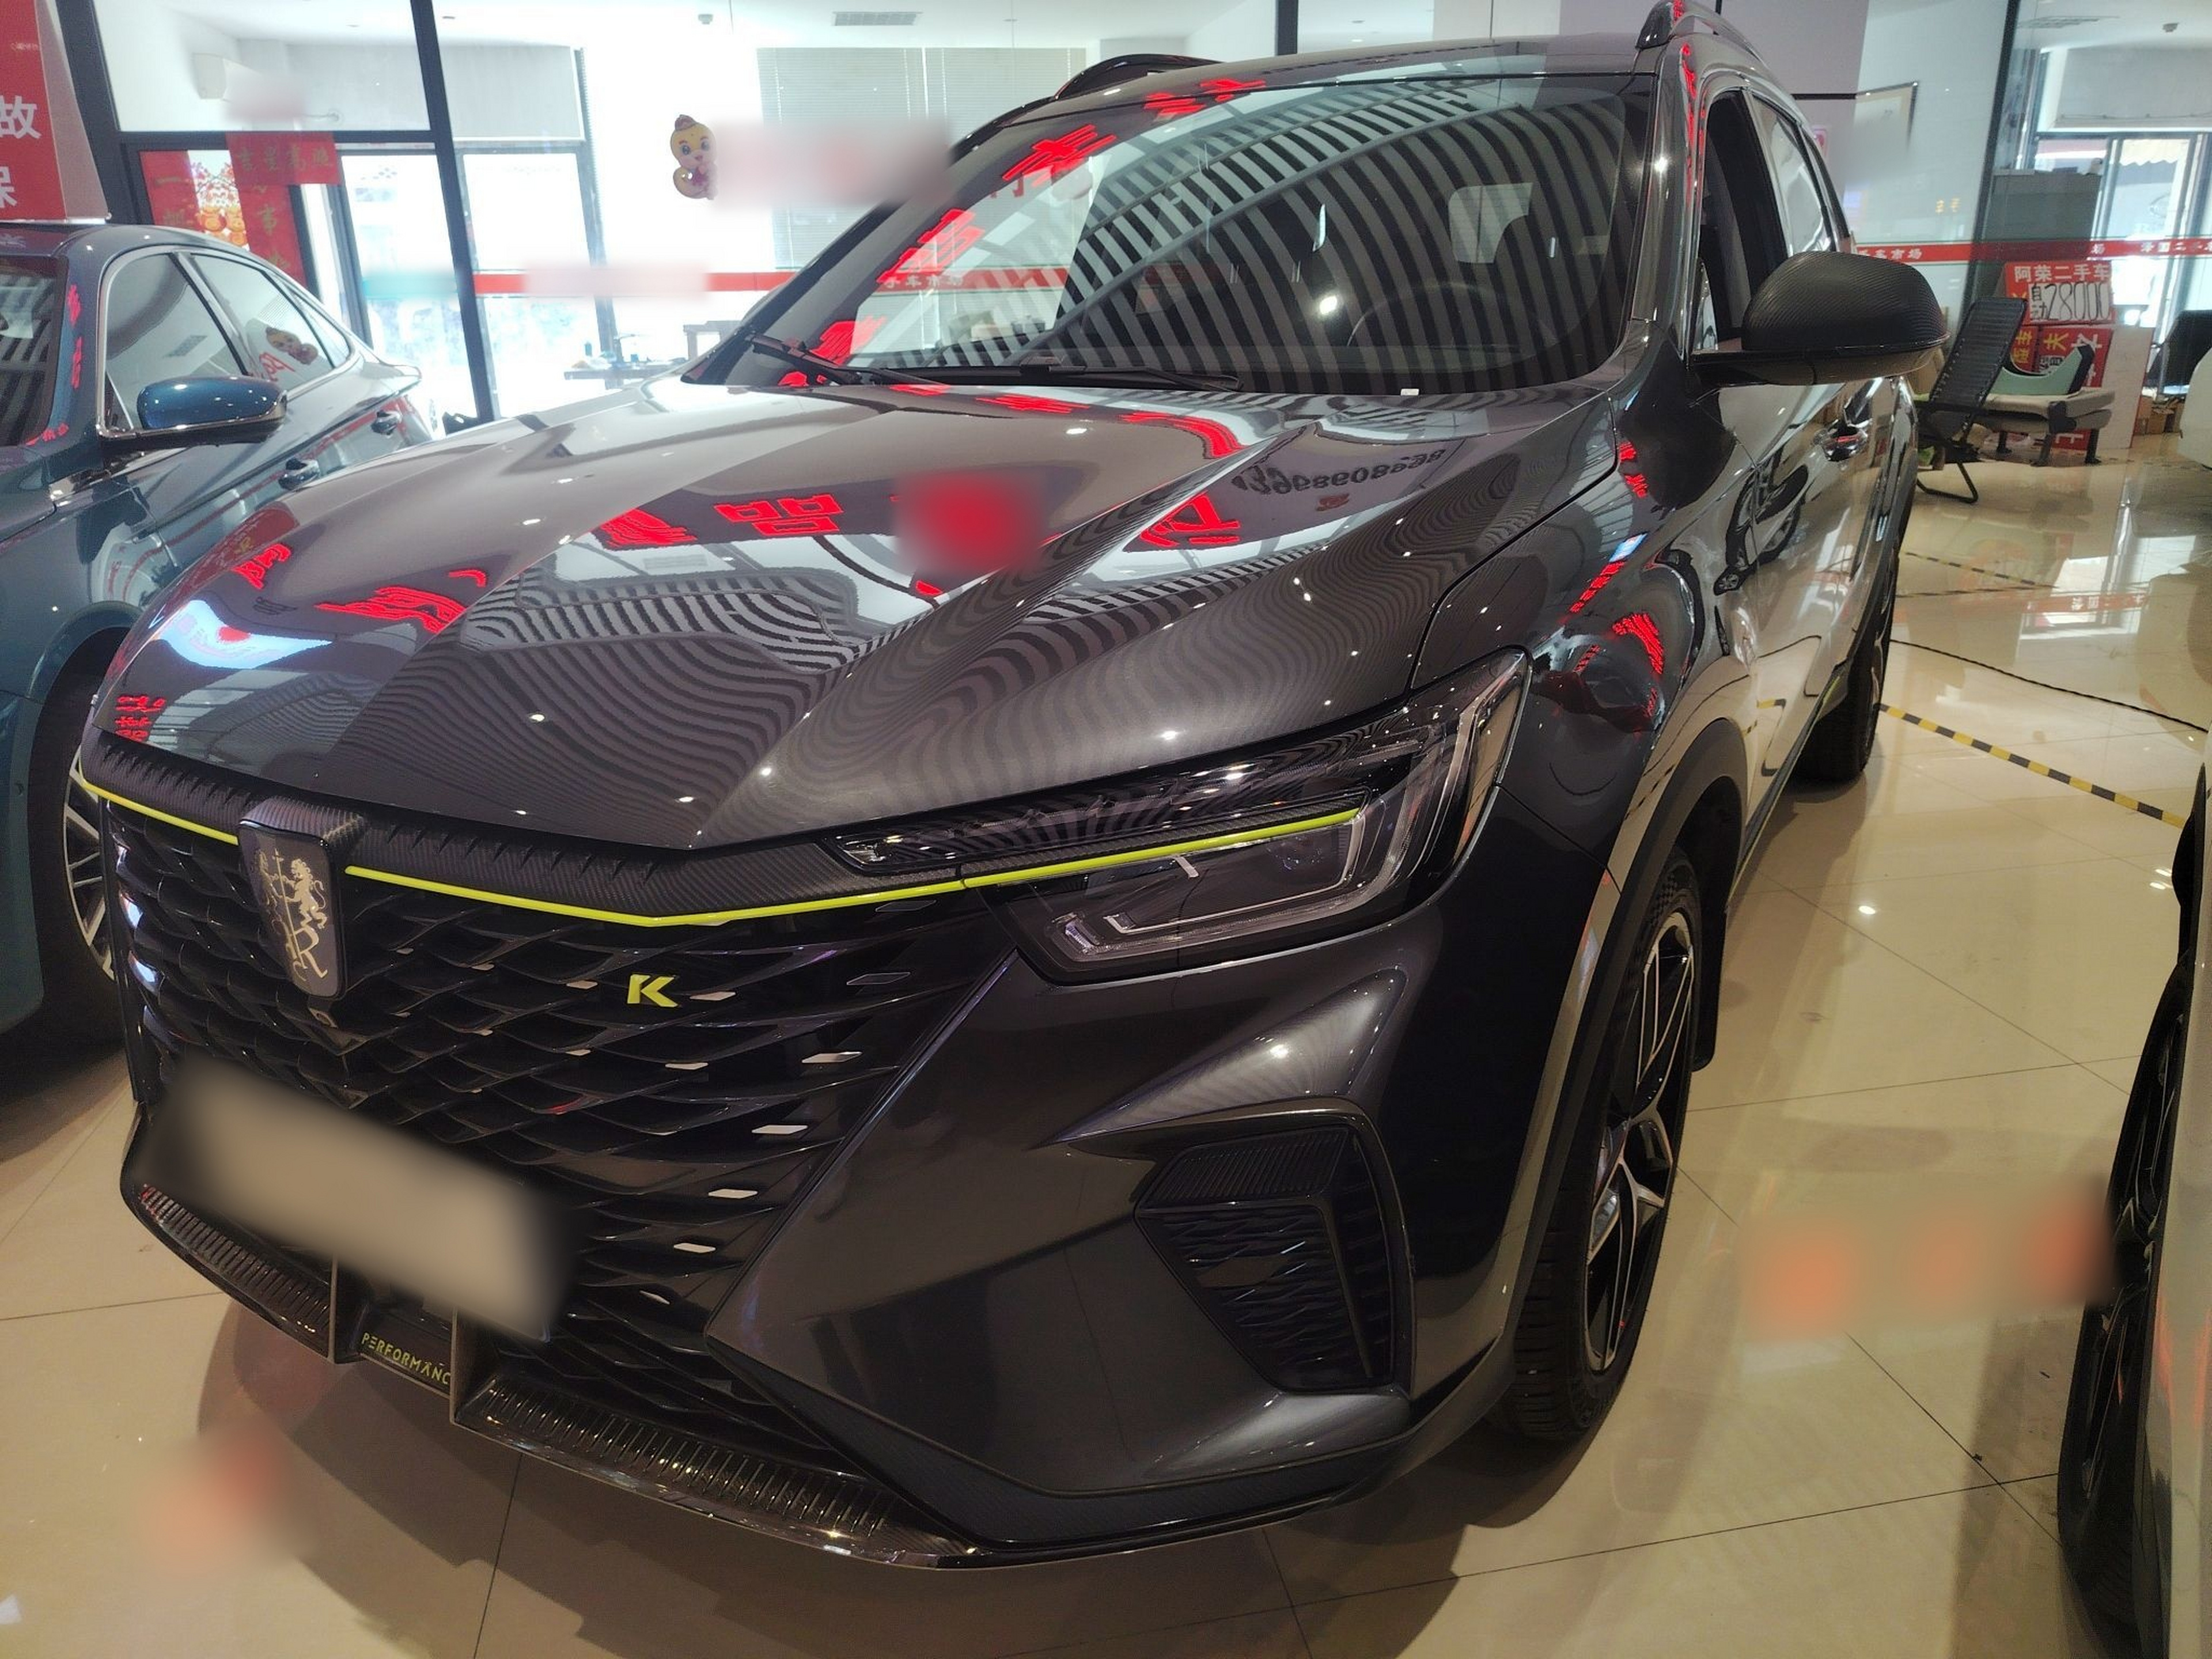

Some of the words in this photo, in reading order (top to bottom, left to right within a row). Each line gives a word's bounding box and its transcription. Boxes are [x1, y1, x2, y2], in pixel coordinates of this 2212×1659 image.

[2014, 263, 2109, 283] 阿荣二手车
[627, 974, 679, 1007] K
